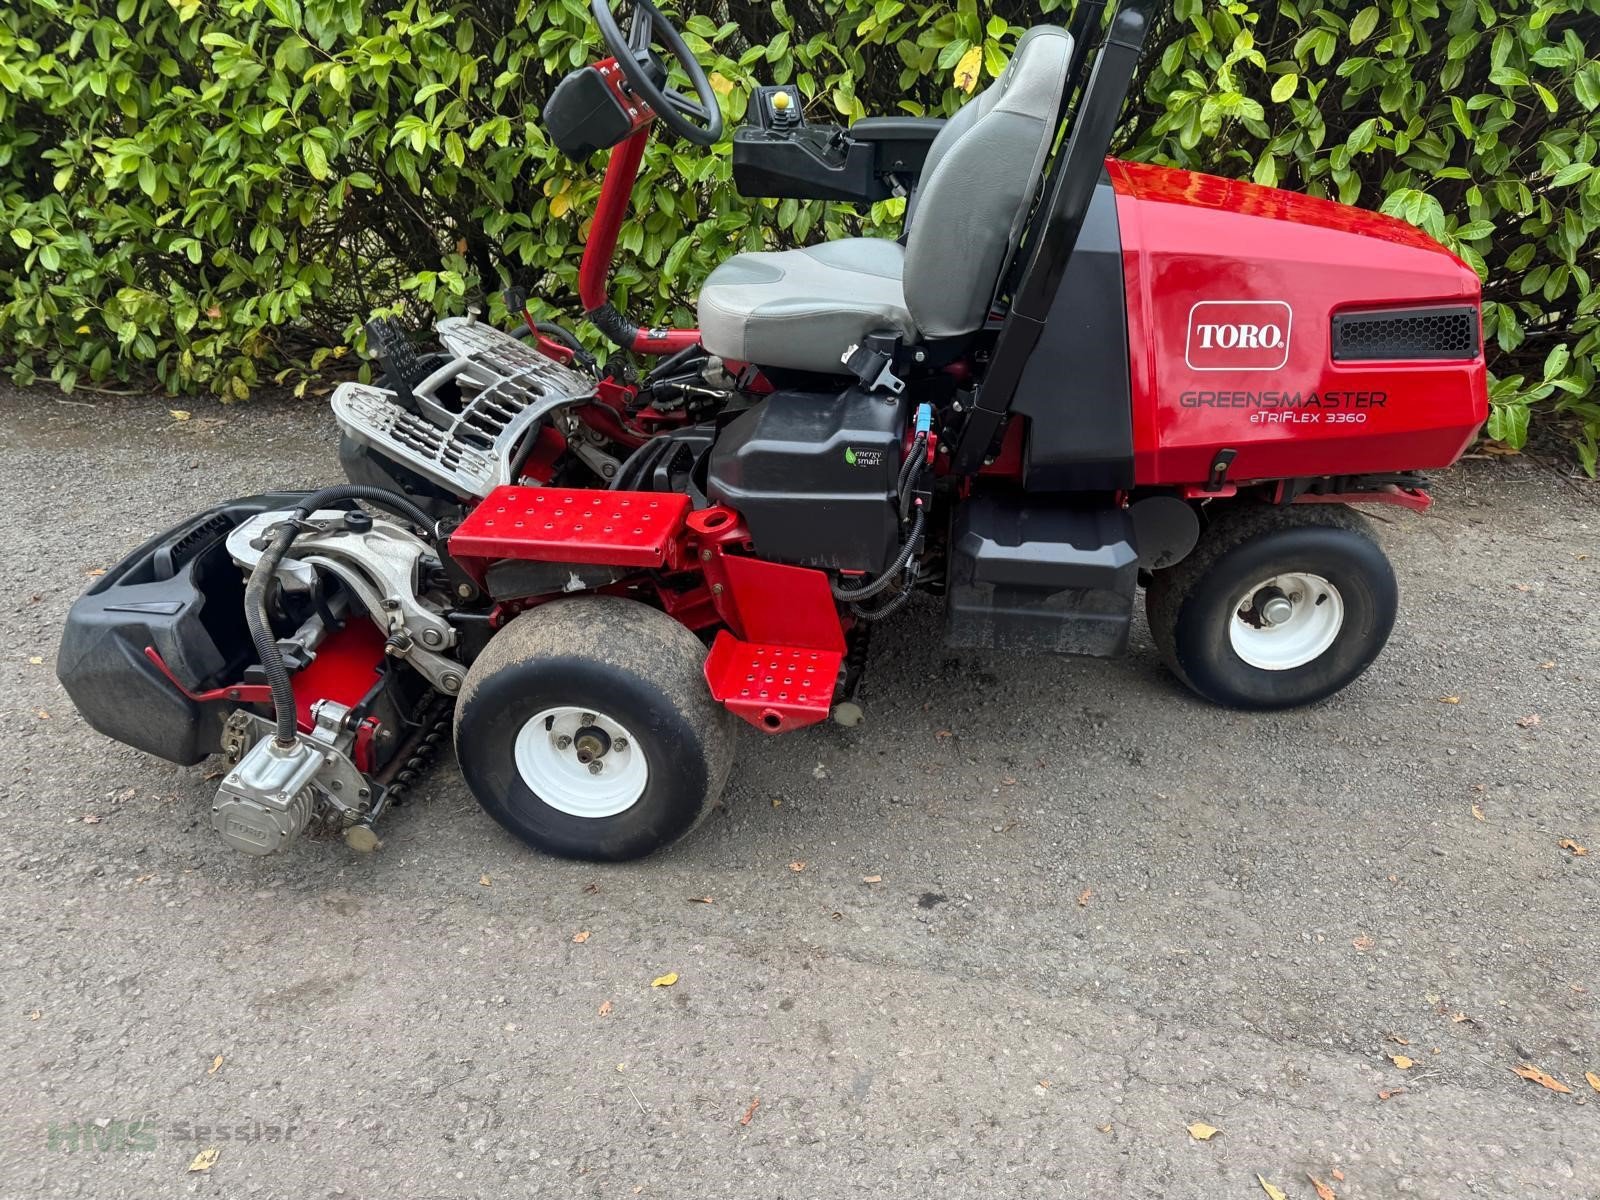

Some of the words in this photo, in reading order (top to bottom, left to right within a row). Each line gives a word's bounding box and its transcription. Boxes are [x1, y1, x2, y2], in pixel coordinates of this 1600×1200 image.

[1179, 391, 1388, 409] GREENSMASTER
[1325, 413, 1367, 423] 3360
[855, 451, 882, 460] energy
